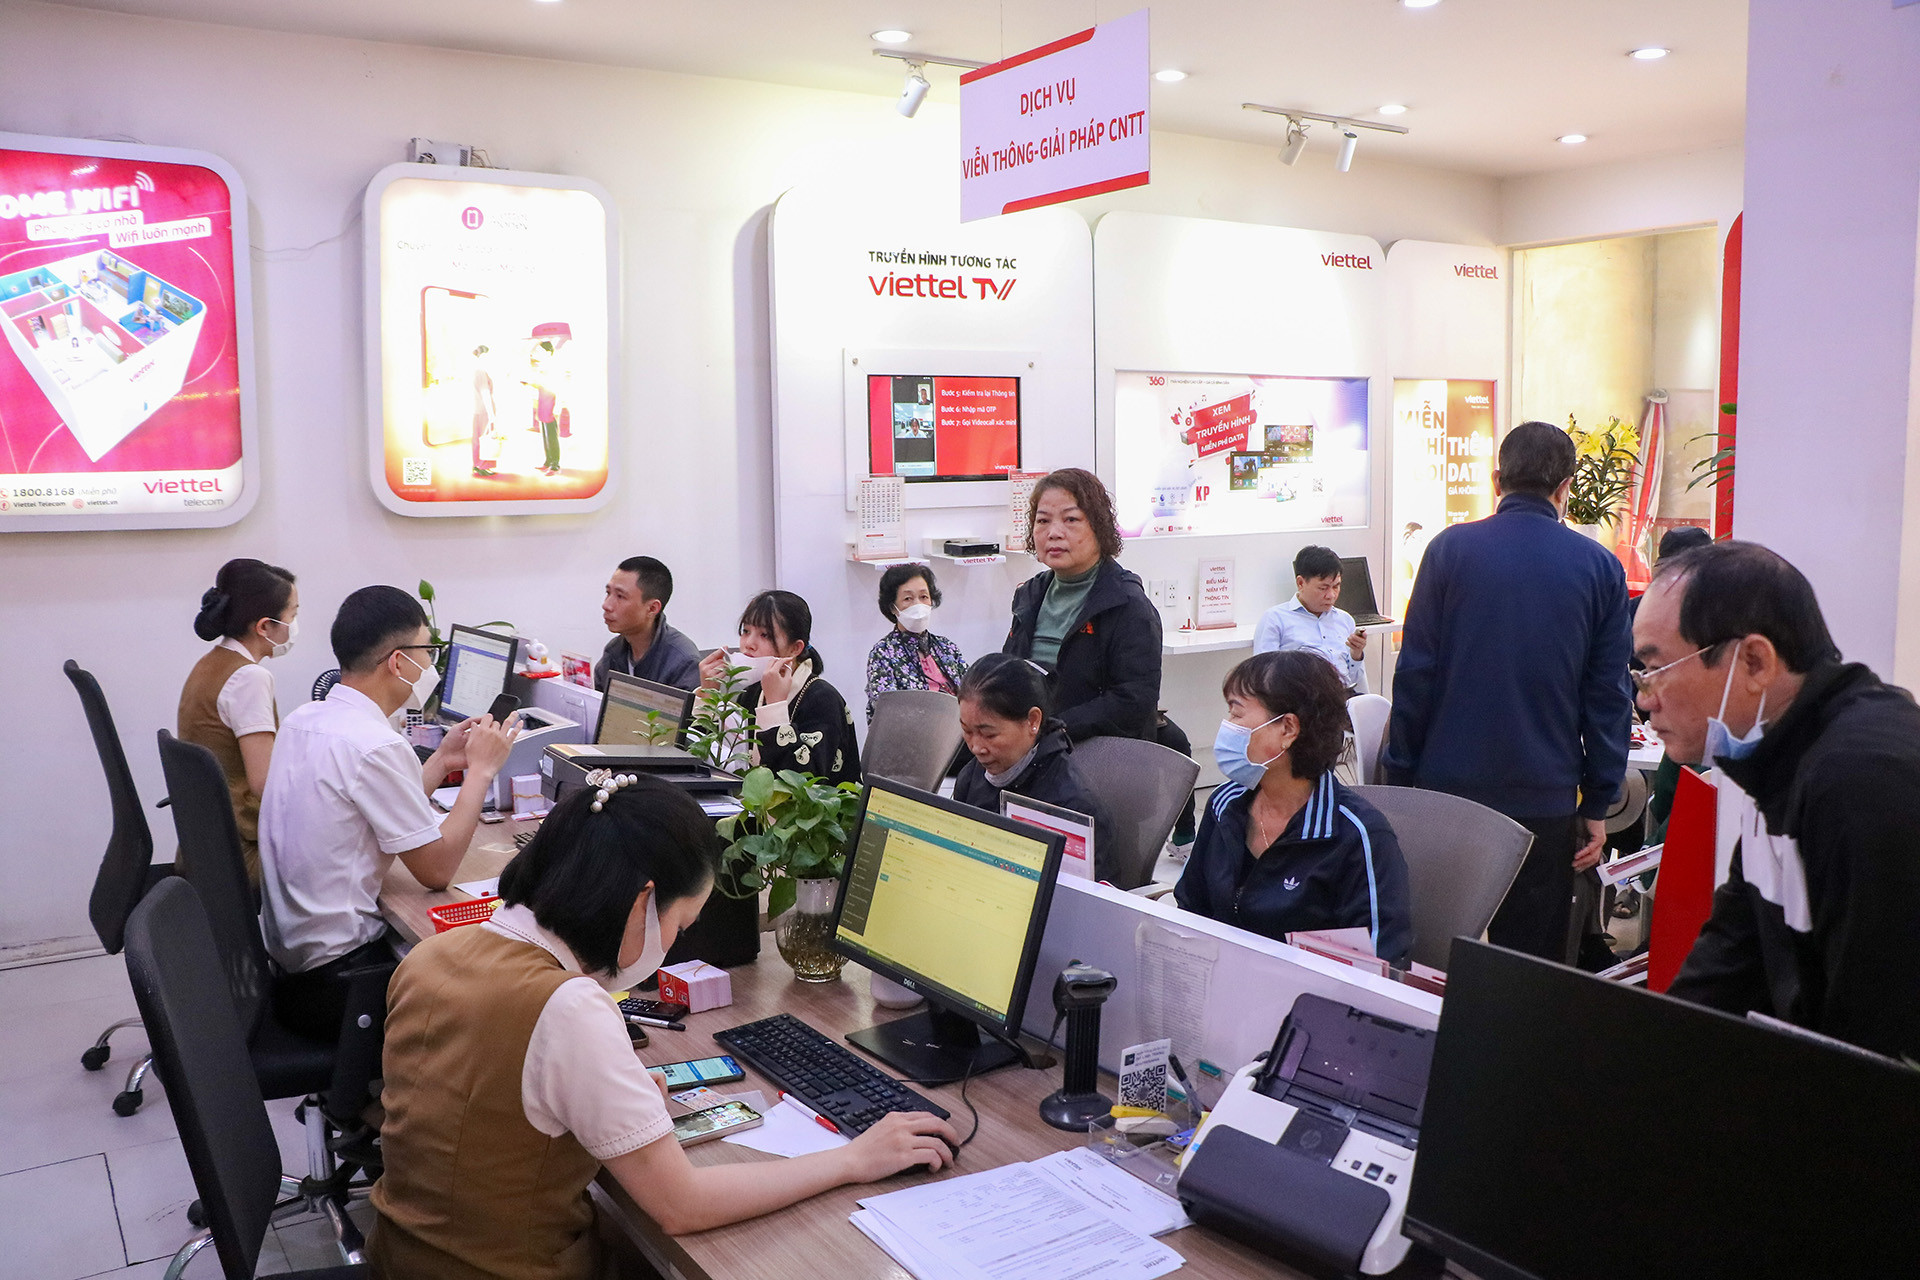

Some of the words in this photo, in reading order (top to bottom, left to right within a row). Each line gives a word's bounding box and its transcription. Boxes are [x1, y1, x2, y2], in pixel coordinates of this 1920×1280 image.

[1020, 85, 1052, 117] DỊCH
[1056, 77, 1076, 105] VỤ
[962, 146, 989, 180] VIỄN
[992, 127, 1065, 172] THÔNG-GIẢI
[1070, 118, 1105, 152] PHÁP
[1109, 110, 1145, 142] CNTT
[71, 185, 140, 215] WIFI
[114, 214, 137, 227] nhà
[116, 230, 139, 243] Wifi
[142, 227, 168, 240] luôn
[172, 222, 206, 237] mạnh
[919, 250, 947, 266] HÌNH
[950, 254, 991, 269] TƯƠNG
[996, 256, 1017, 270] TÁC
[1320, 251, 1373, 270] viettel
[1453, 263, 1499, 280] viettel
[868, 271, 968, 299] viettel
[1212, 403, 1231, 417] XEM
[1195, 418, 1230, 440] TRUYỀN
[1230, 414, 1251, 428] HÌNH
[1200, 440, 1217, 453] MIỄN
[1228, 432, 1245, 444] DATA
[13, 487, 75, 497] 1800.8168
[143, 478, 223, 494] viettel
[183, 497, 224, 507] telecom
